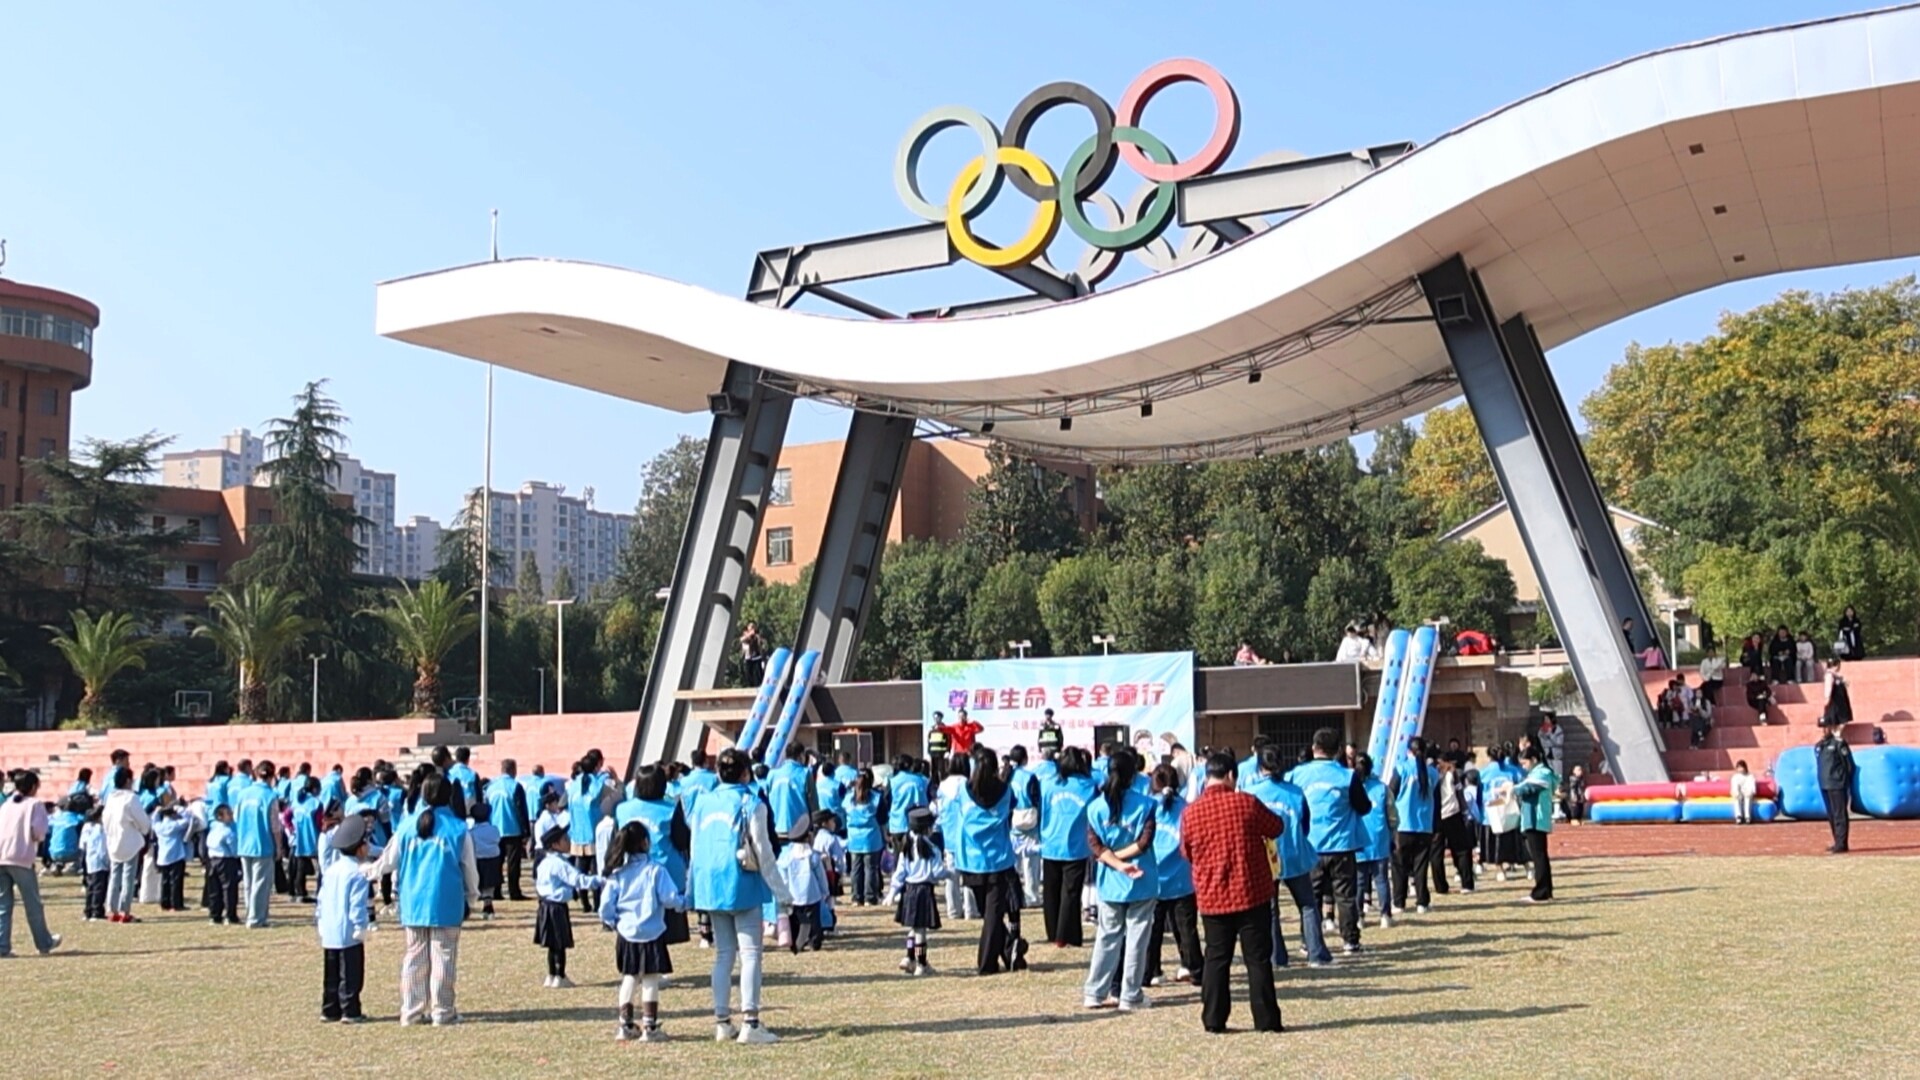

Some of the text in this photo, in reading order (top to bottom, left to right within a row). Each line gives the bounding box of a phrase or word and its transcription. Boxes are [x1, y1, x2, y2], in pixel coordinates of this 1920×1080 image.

[948, 683, 1165, 711] 尊重生命 安全童行
